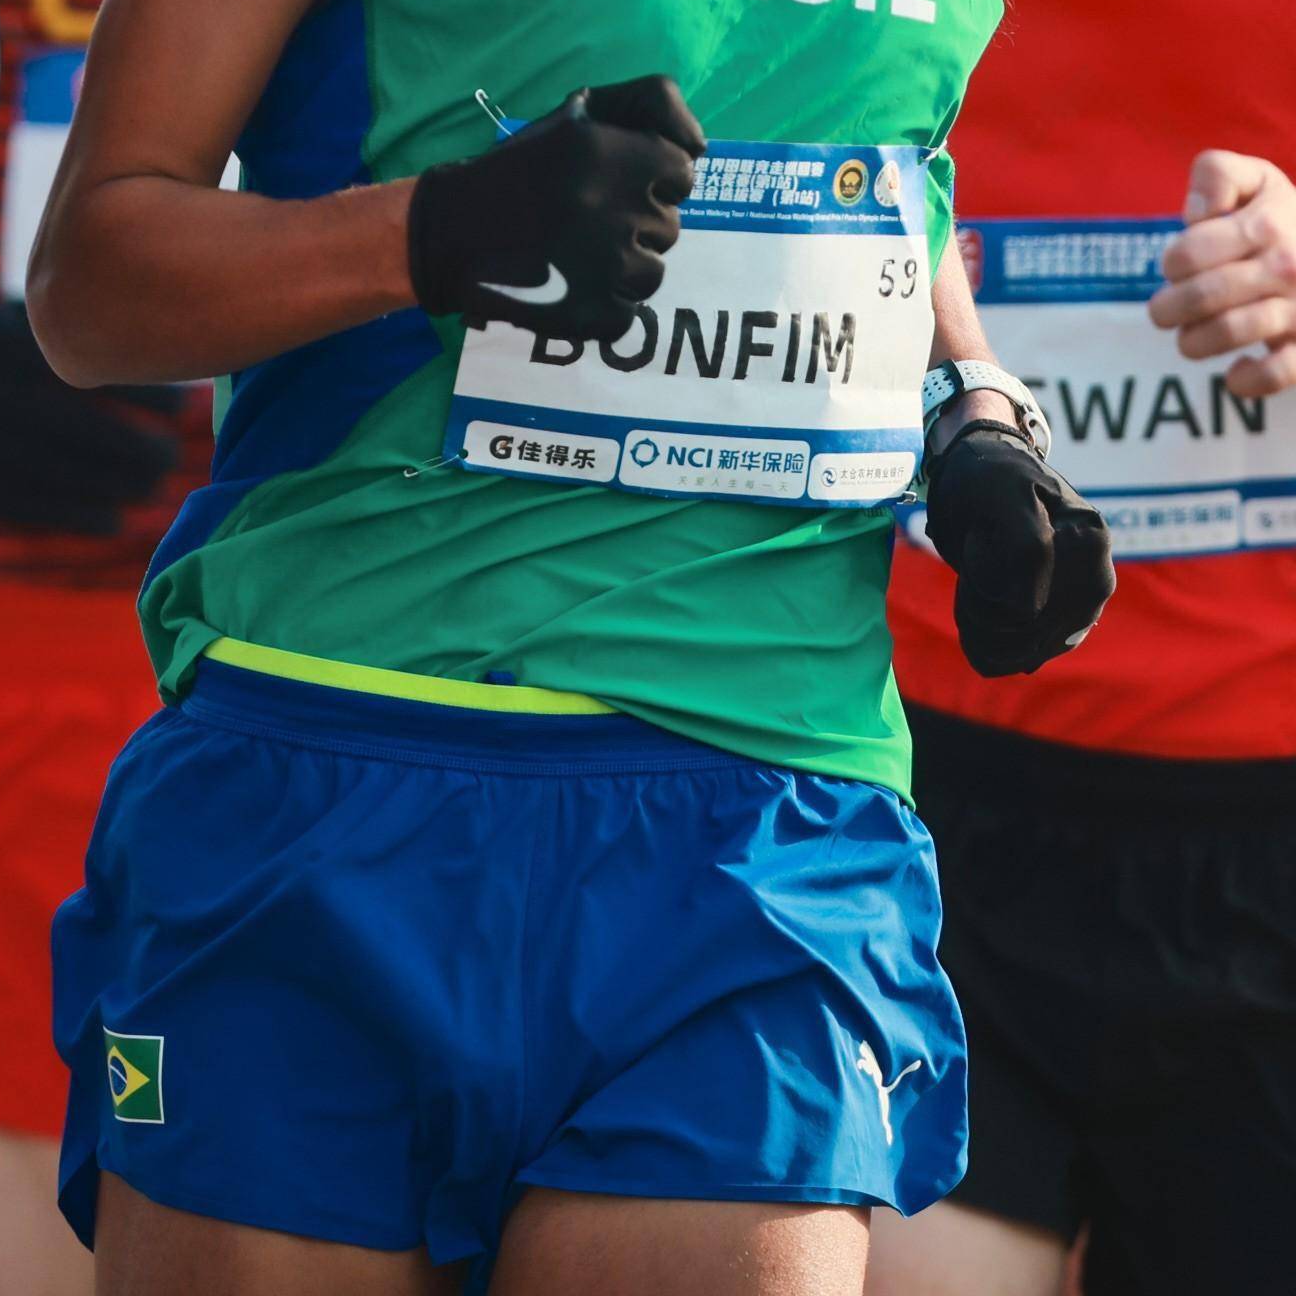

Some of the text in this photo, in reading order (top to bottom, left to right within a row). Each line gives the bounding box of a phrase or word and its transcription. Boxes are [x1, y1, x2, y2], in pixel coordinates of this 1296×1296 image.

[878, 259, 917, 299] 59
[517, 439, 596, 469] 佳得乐
[666, 446, 804, 474] NCI 新华保险
